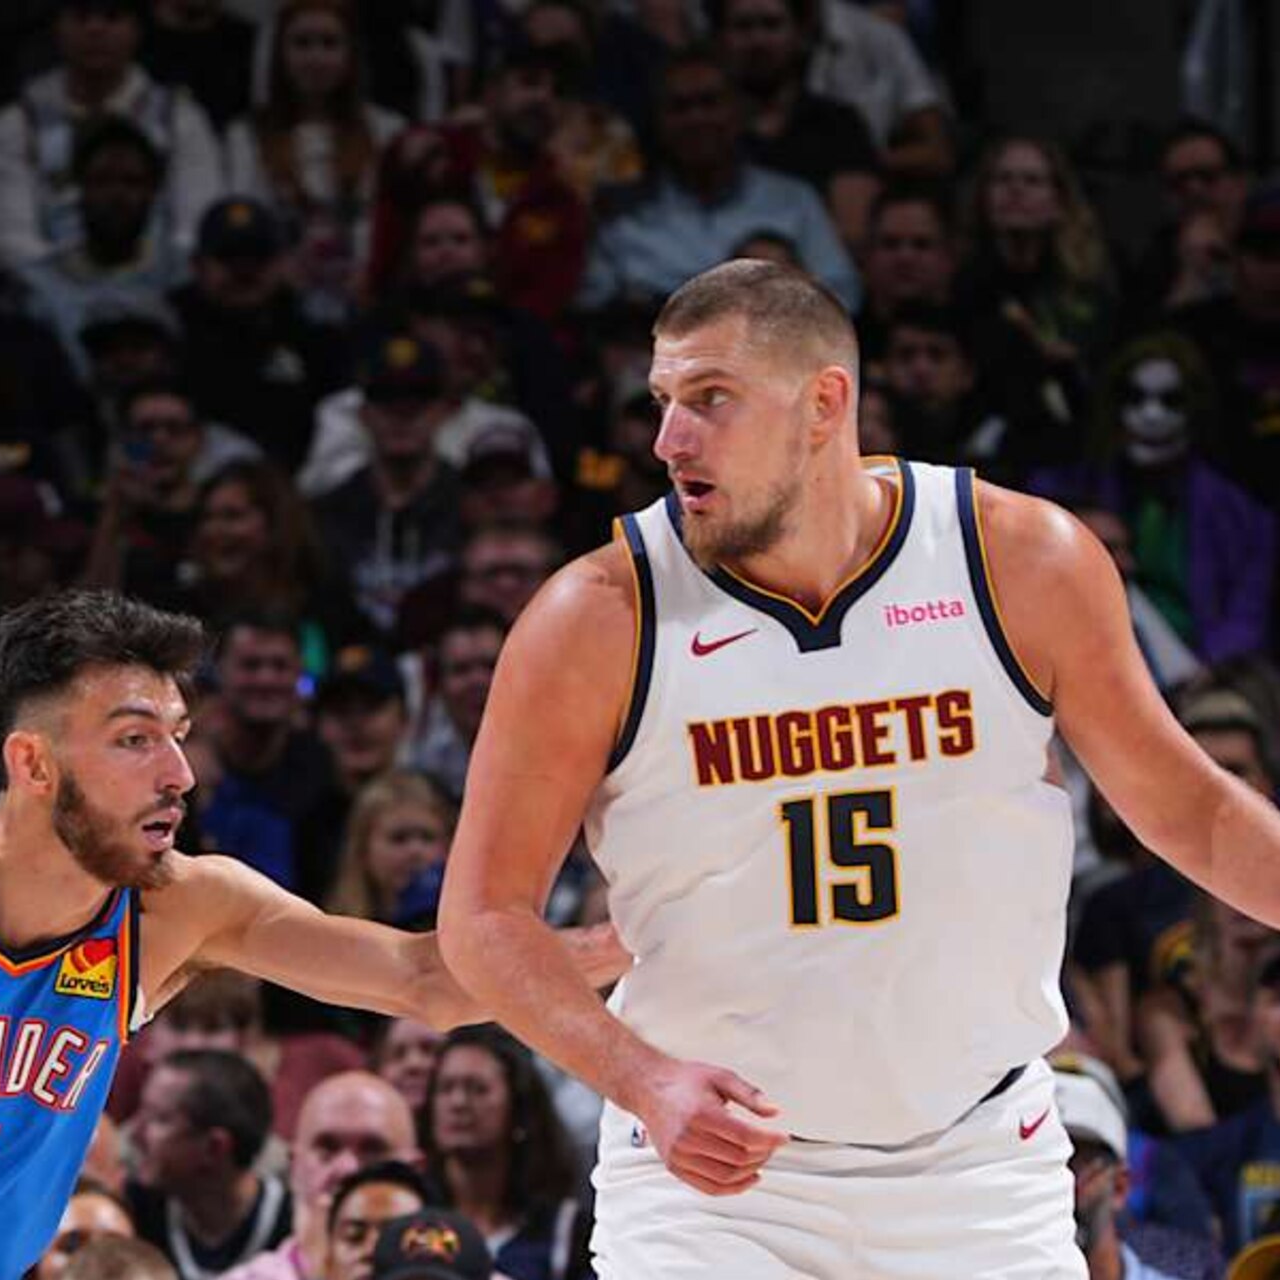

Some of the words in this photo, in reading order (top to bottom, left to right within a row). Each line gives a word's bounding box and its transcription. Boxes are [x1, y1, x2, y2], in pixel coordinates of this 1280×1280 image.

[884, 599, 965, 627] ibotta
[686, 688, 977, 788] NUGGETS
[776, 785, 901, 930] 15
